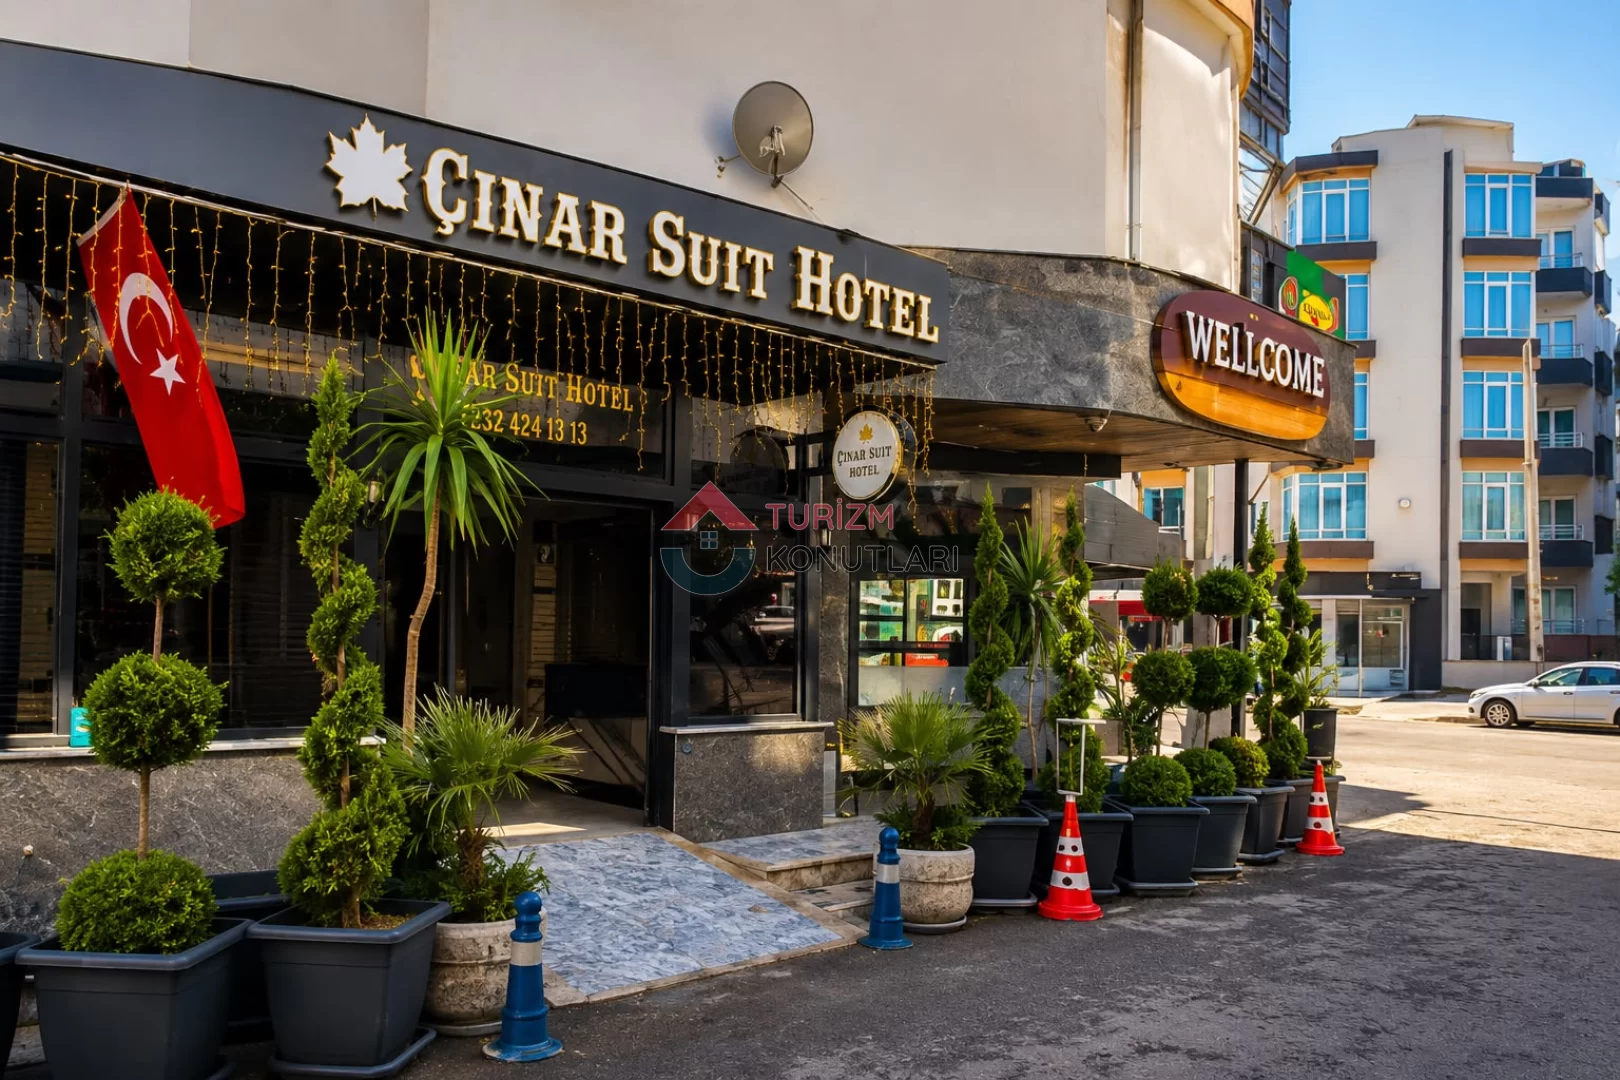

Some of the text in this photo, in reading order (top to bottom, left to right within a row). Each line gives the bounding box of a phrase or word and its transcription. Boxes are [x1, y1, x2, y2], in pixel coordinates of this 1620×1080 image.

[422, 147, 940, 344] ÇINAR SUIT HOTEL
[1184, 310, 1326, 399] WELLCOME
[504, 362, 558, 399] SUIT
[566, 371, 635, 413] HOTEL
[461, 403, 588, 446] 232 424 13 13
[836, 445, 892, 467] ÇINAR SUIT
[848, 465, 880, 480] HOTEL
